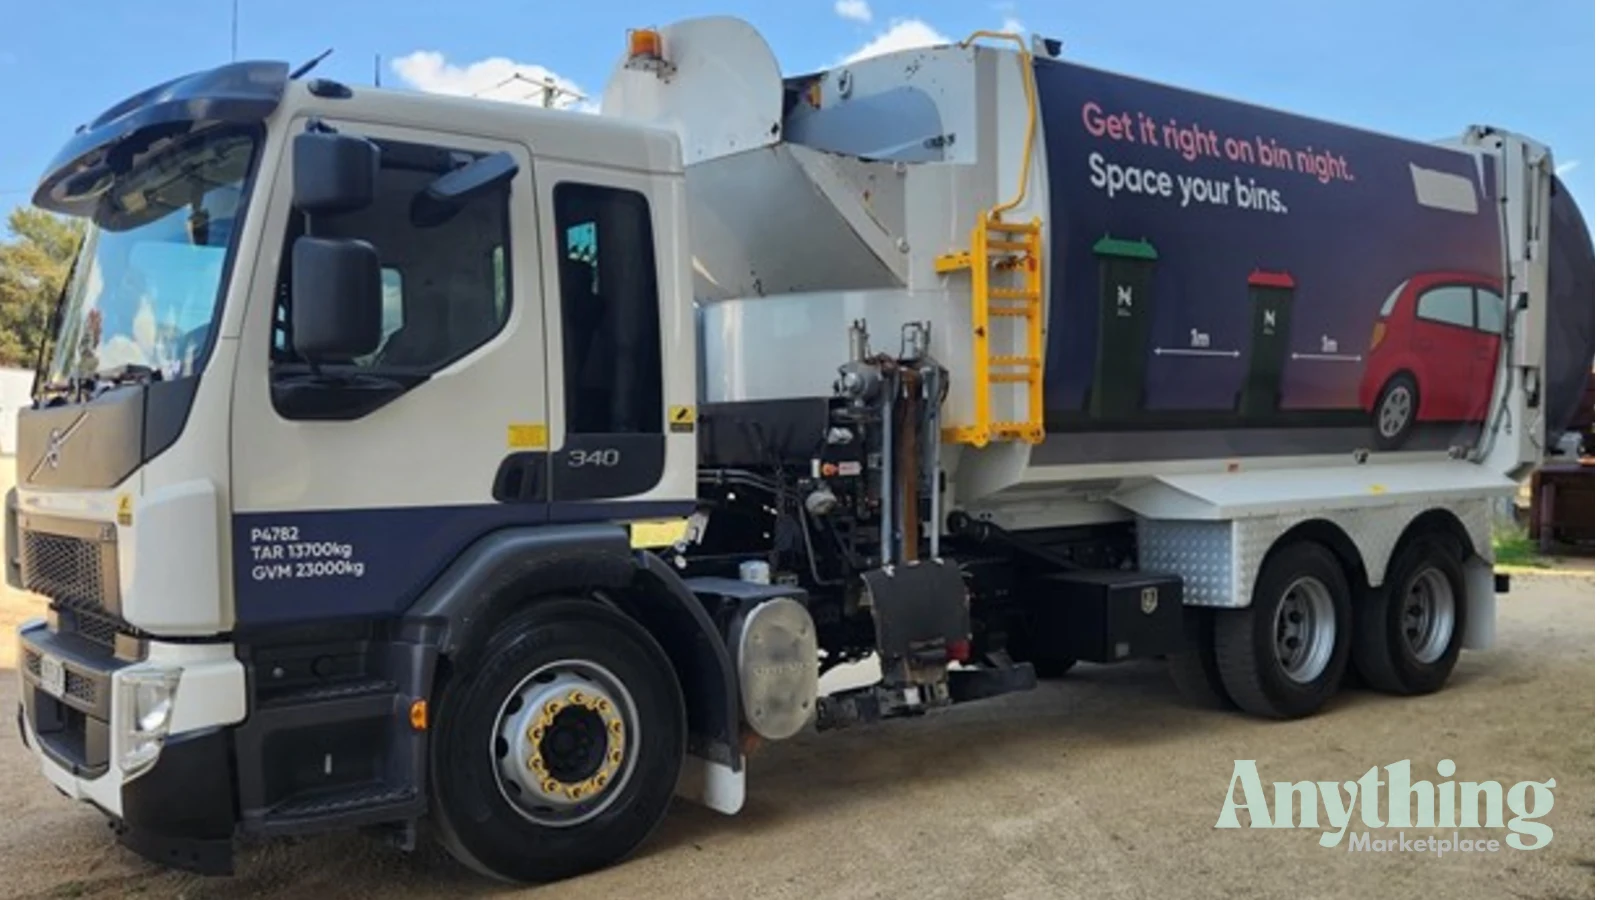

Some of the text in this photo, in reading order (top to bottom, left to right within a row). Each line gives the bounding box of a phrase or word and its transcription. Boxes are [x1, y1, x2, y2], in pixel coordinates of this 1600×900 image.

[1082, 102, 1355, 184] Get it right on bin night.
[1088, 153, 1288, 214] Space your bins.
[1190, 328, 1210, 347] 1m
[1321, 335, 1338, 352] 1m
[567, 448, 620, 468] 340
[251, 526, 300, 542] P4782
[251, 542, 353, 560] TAR 13700kg
[251, 560, 365, 581] GVM 23000kg
